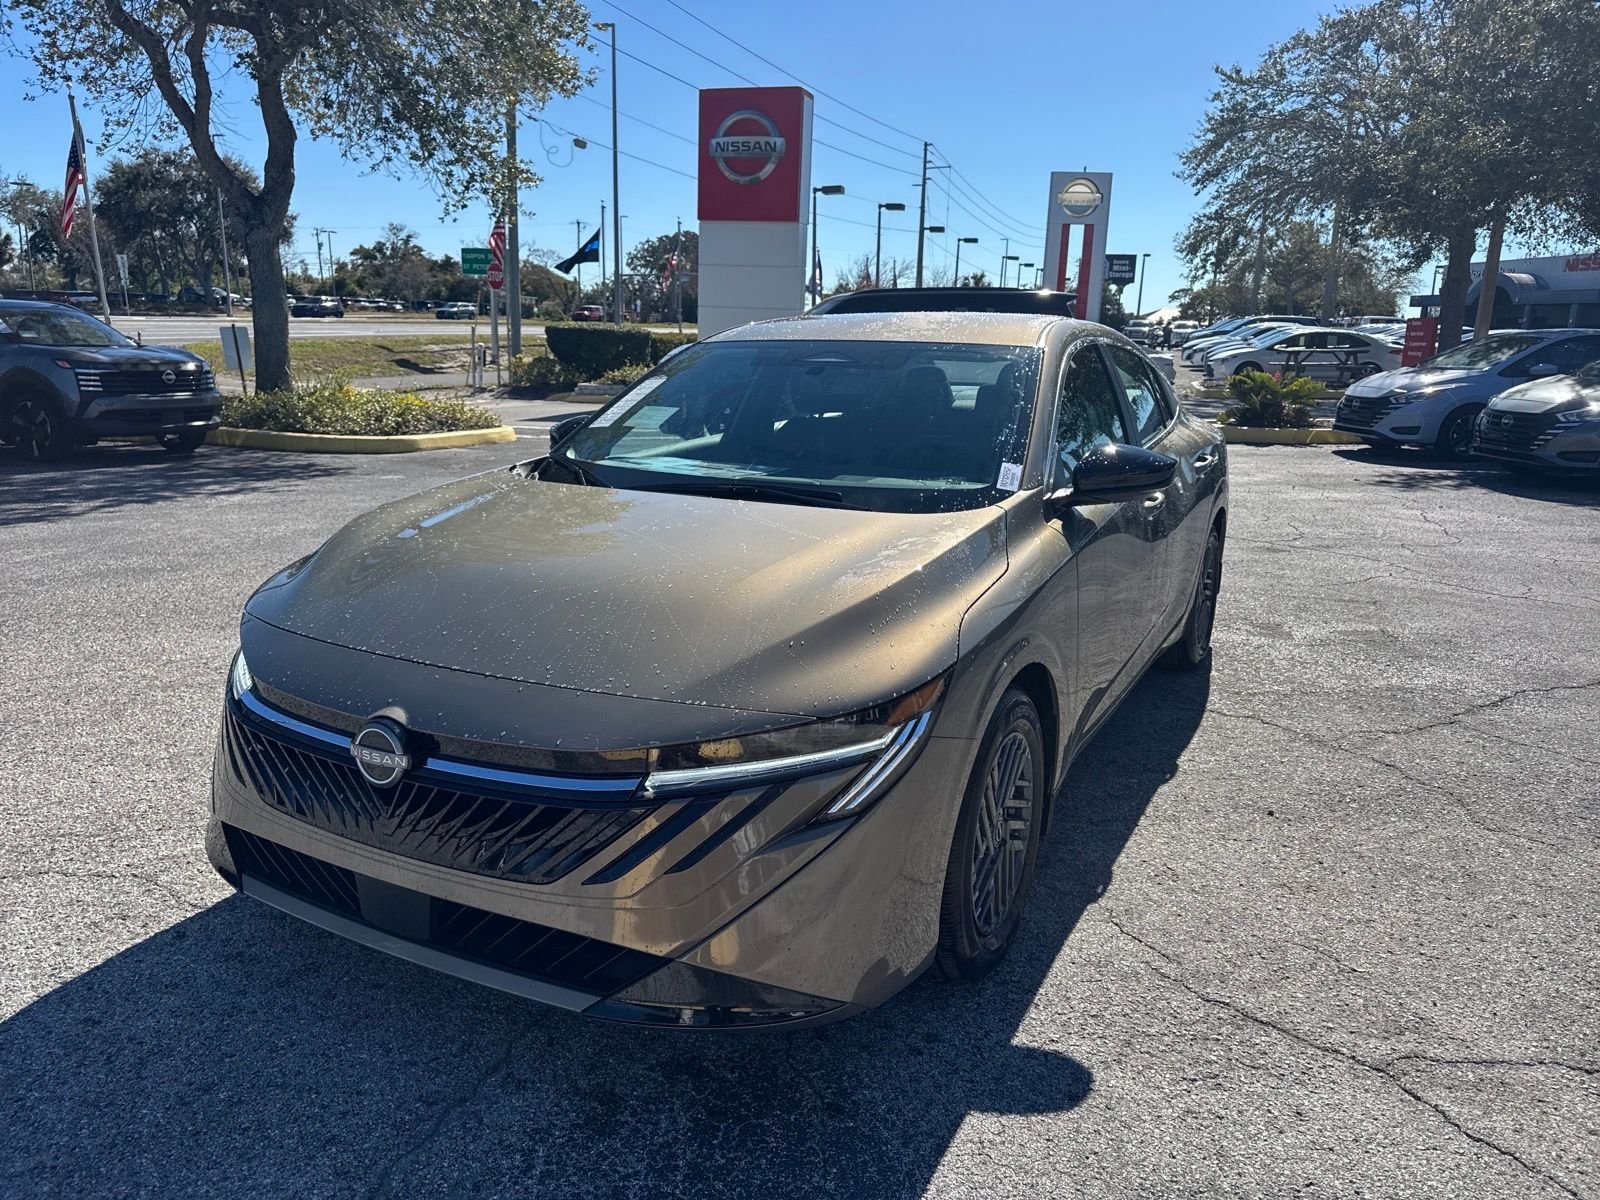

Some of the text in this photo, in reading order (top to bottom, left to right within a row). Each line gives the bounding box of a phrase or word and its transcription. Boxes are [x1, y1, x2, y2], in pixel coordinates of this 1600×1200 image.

[715, 141, 777, 153] NISSAN
[487, 270, 503, 282] STOP
[351, 745, 406, 766] NISSAN
